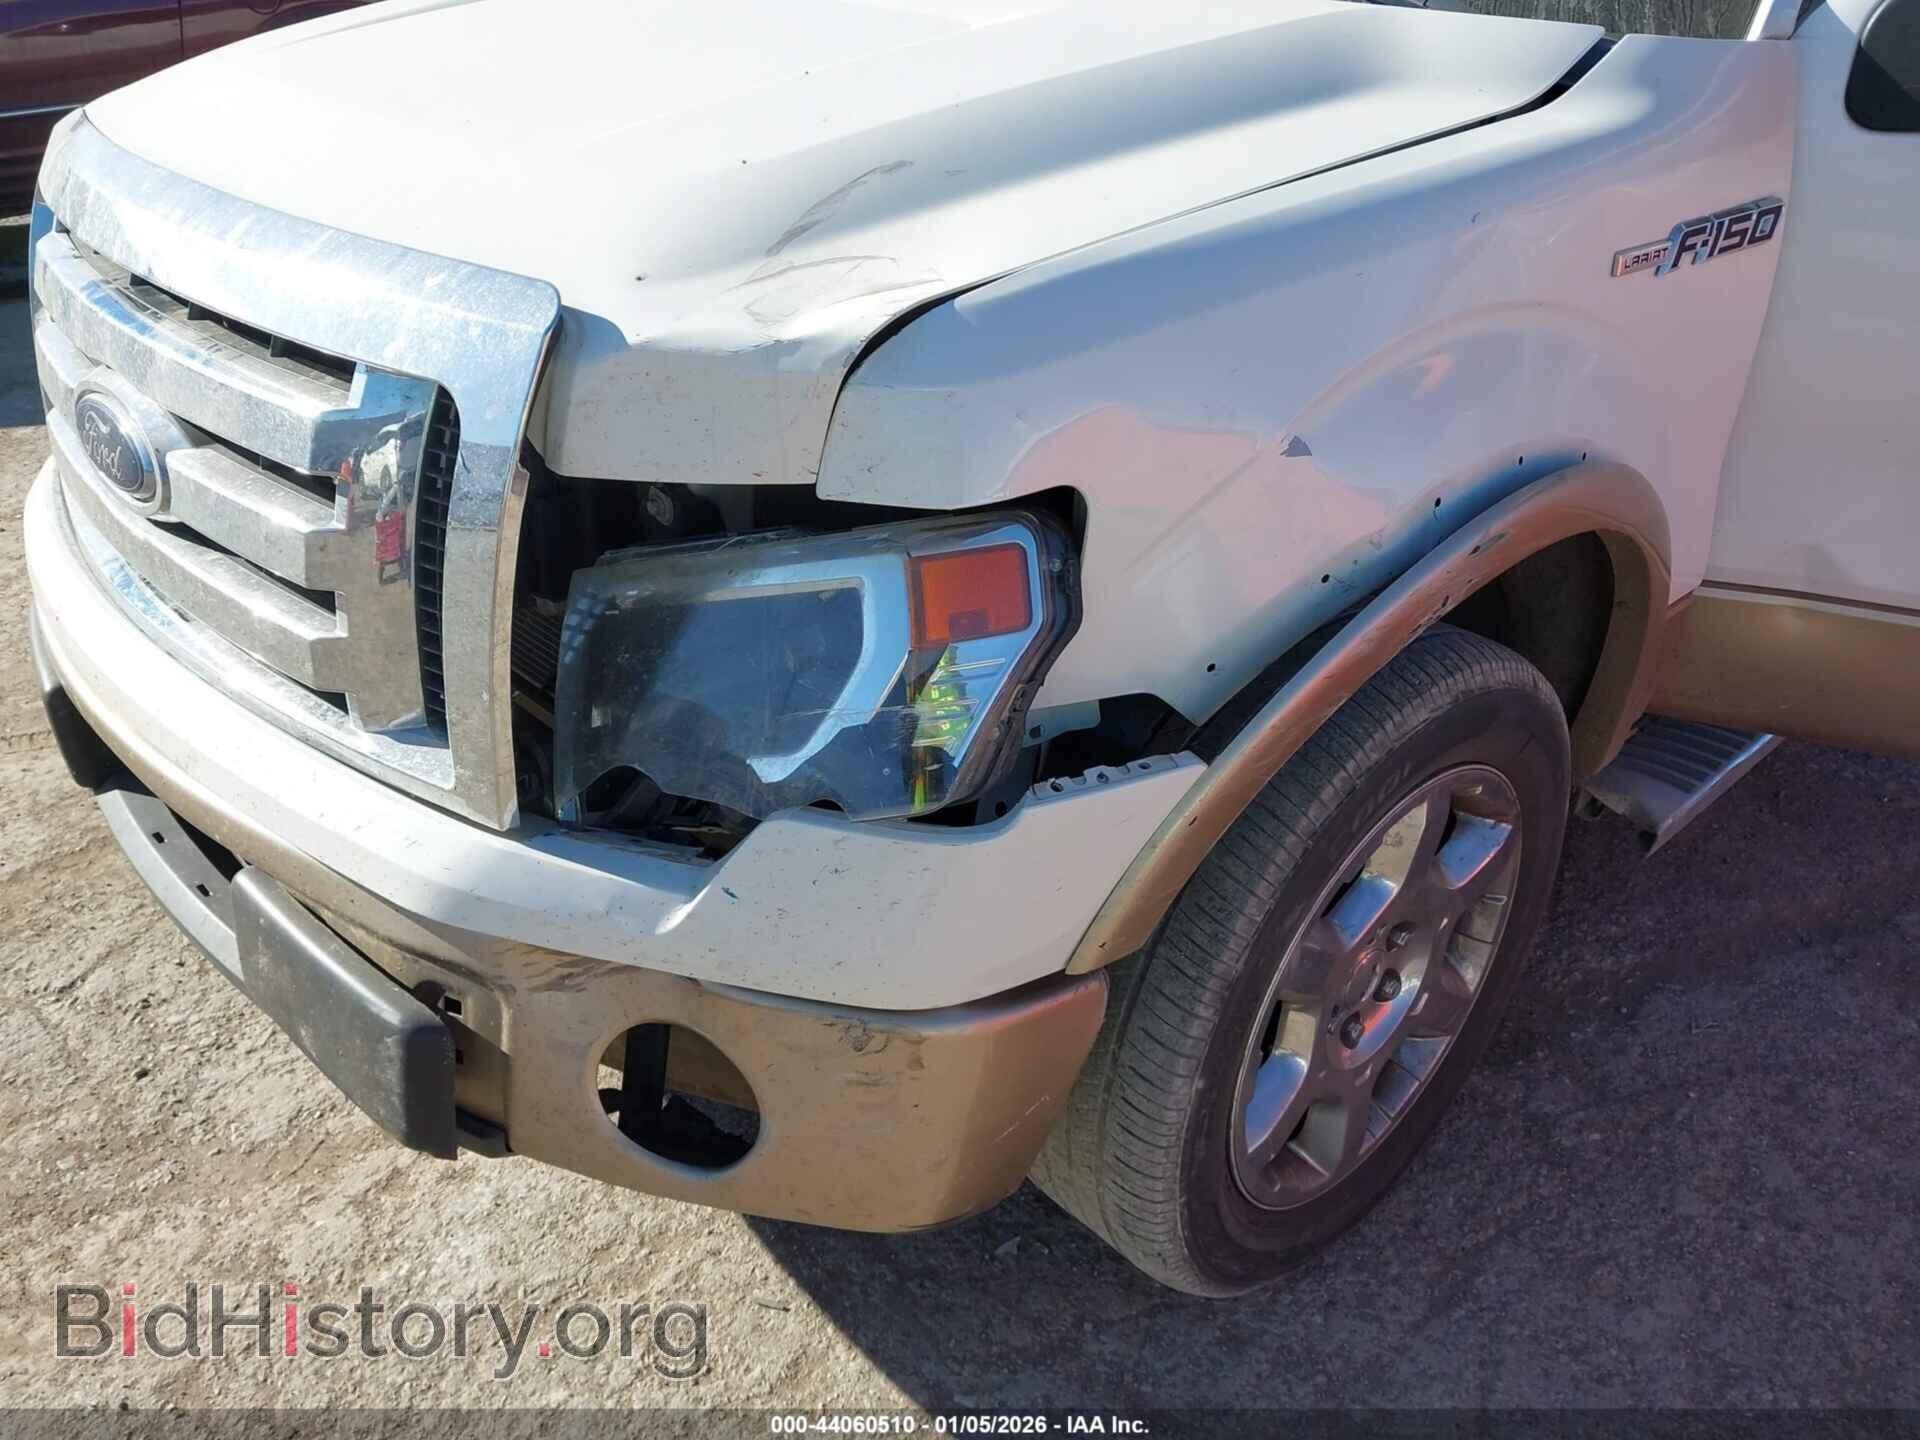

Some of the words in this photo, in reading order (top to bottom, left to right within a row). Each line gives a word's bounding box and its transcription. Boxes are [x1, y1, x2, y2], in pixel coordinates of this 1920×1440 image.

[1622, 247, 1669, 270] LARIAT
[1660, 197, 1785, 273] F-150
[81, 409, 123, 482] Ford
